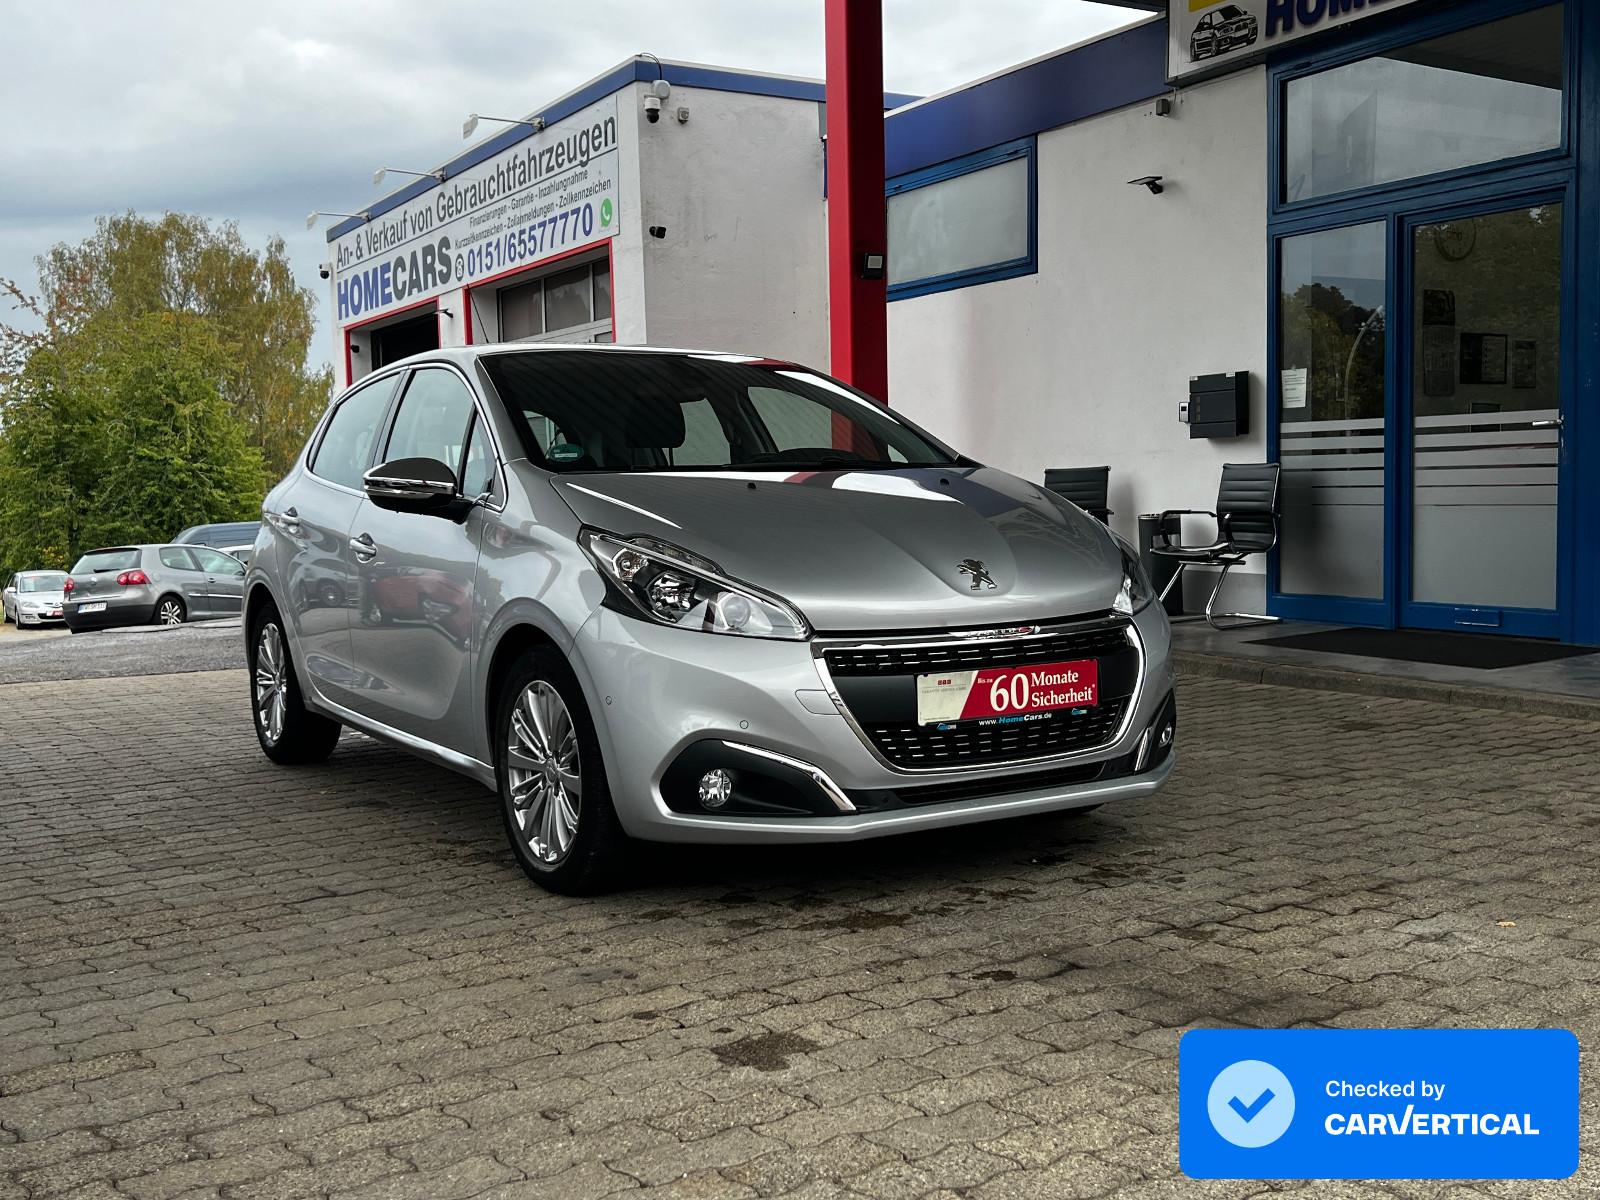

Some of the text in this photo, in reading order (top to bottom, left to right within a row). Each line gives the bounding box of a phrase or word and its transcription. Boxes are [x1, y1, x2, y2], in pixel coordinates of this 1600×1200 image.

[337, 116, 616, 270] An- & Verkauf von Gebrauchtfahrzeugen
[469, 202, 507, 228] Finanzierungen
[511, 191, 534, 209] Garantie
[538, 169, 588, 198] Inzahlungnahme
[507, 202, 555, 228] Zollanmeldungen
[559, 179, 611, 209] Zollkennzeichen
[467, 202, 593, 277] 0151/65577770
[337, 236, 451, 321] HOMECARS
[990, 673, 1029, 711] 60
[1031, 671, 1079, 687] Monate
